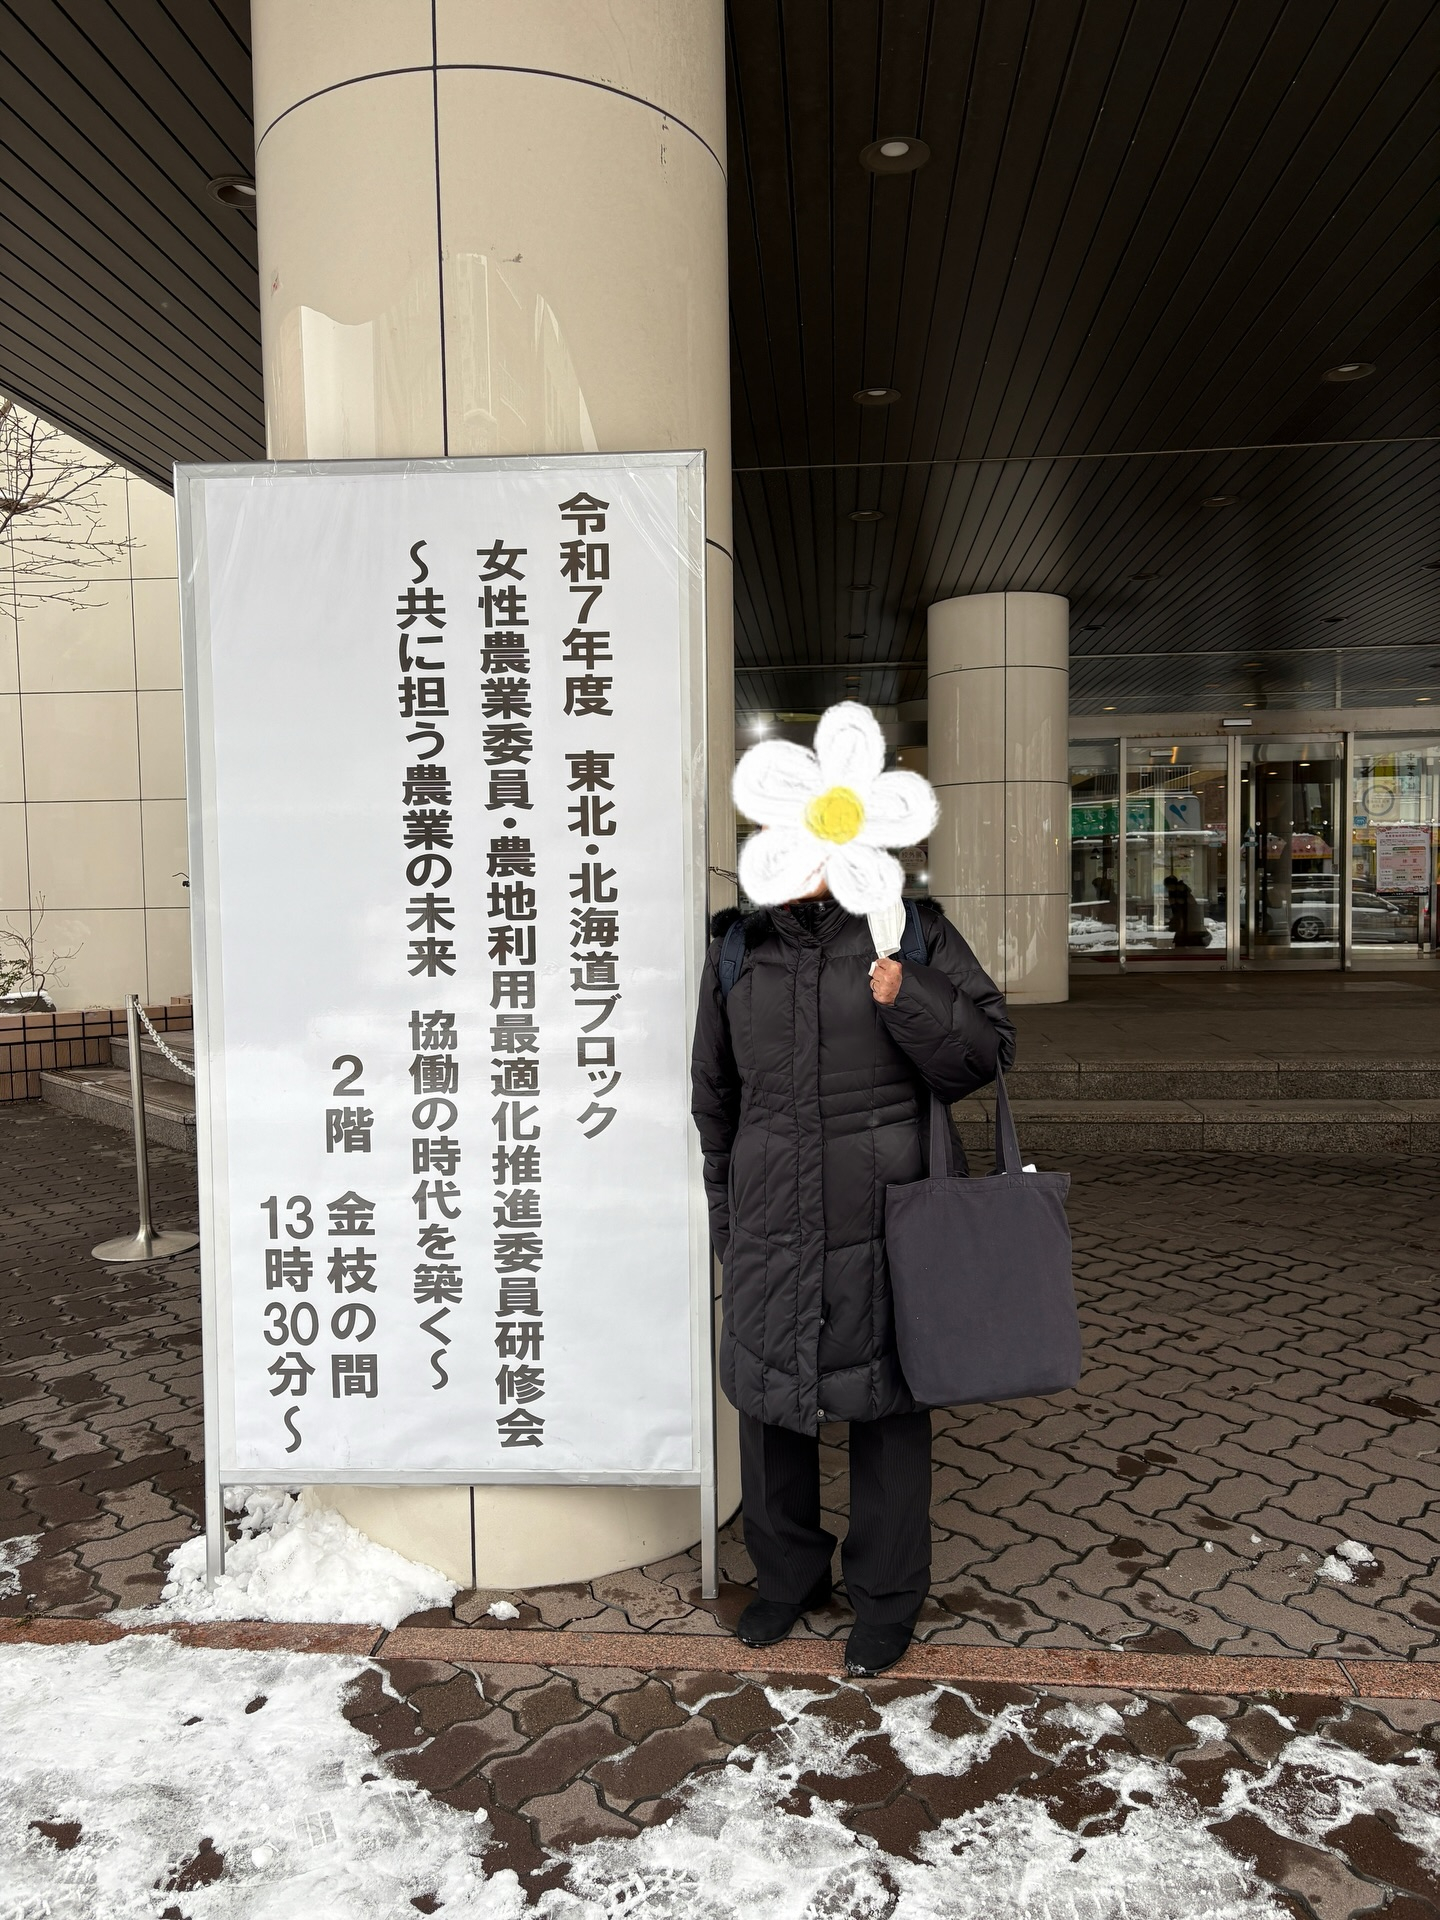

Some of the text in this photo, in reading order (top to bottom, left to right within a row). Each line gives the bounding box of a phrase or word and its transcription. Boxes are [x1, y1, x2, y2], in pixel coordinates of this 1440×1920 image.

[477, 539, 545, 1447] 女性農業委員・農地利用最適化推進委員研修会
[558, 492, 621, 1139] 令和7年度 東北・北海道ブロック
[326, 1055, 378, 1398] 2階 金枝の間
